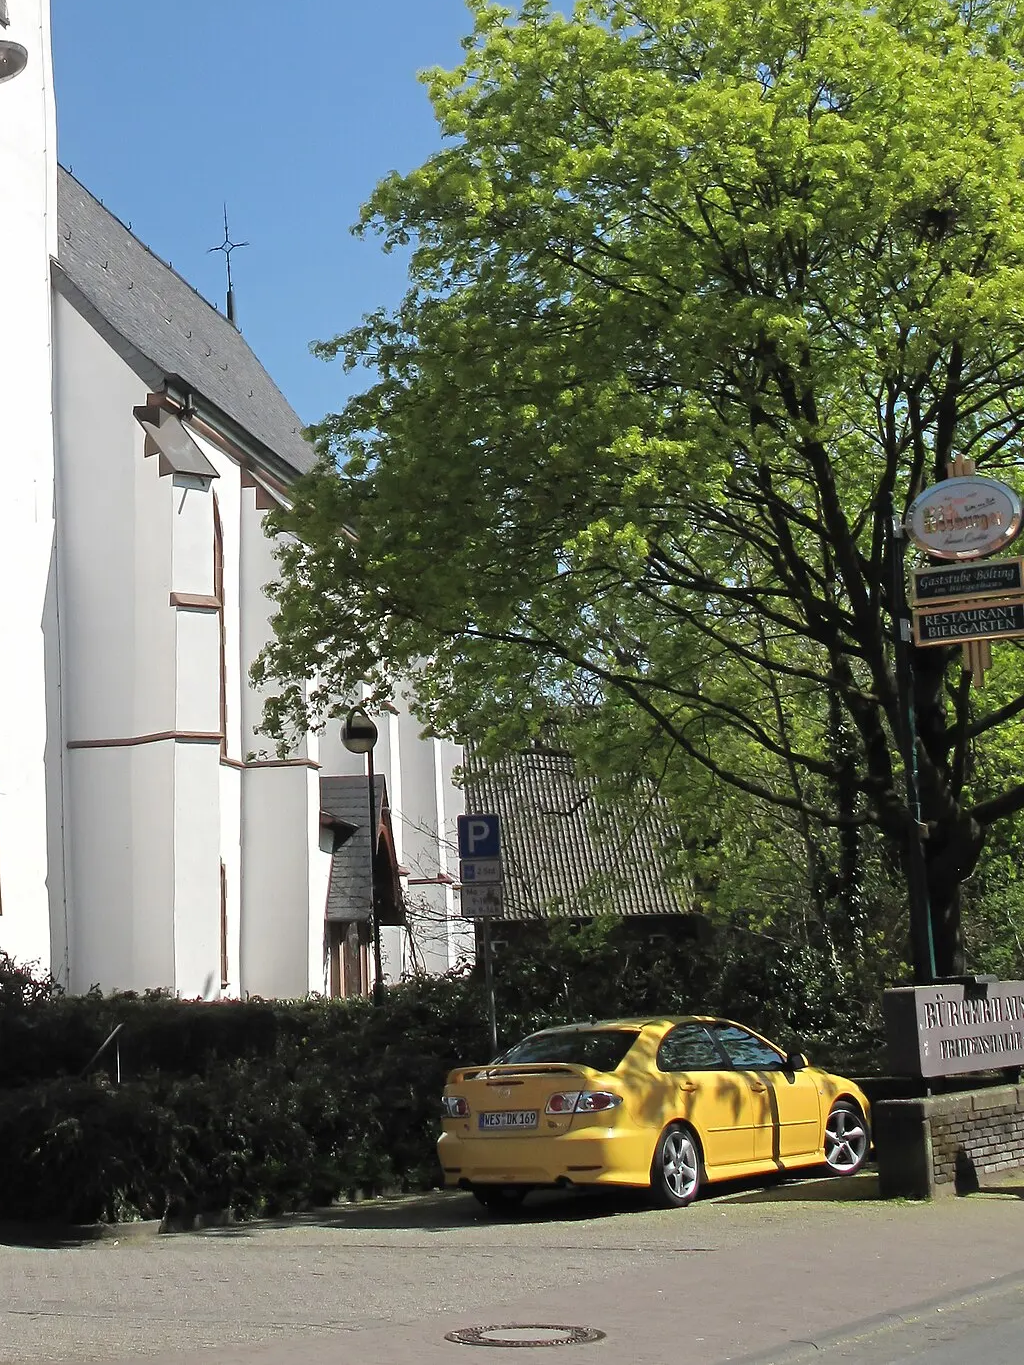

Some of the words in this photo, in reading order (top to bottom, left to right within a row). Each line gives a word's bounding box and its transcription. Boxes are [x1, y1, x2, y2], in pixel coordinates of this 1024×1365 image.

[919, 570, 972, 590] Gaststube
[975, 566, 1015, 581] Bölting
[925, 606, 1016, 626] RESTAURANT
[928, 617, 1016, 638] BIERGARTEN
[468, 821, 490, 853] P
[485, 1113, 500, 1125] WES
[507, 1112, 518, 1125] DK
[520, 1112, 536, 1124] 169
